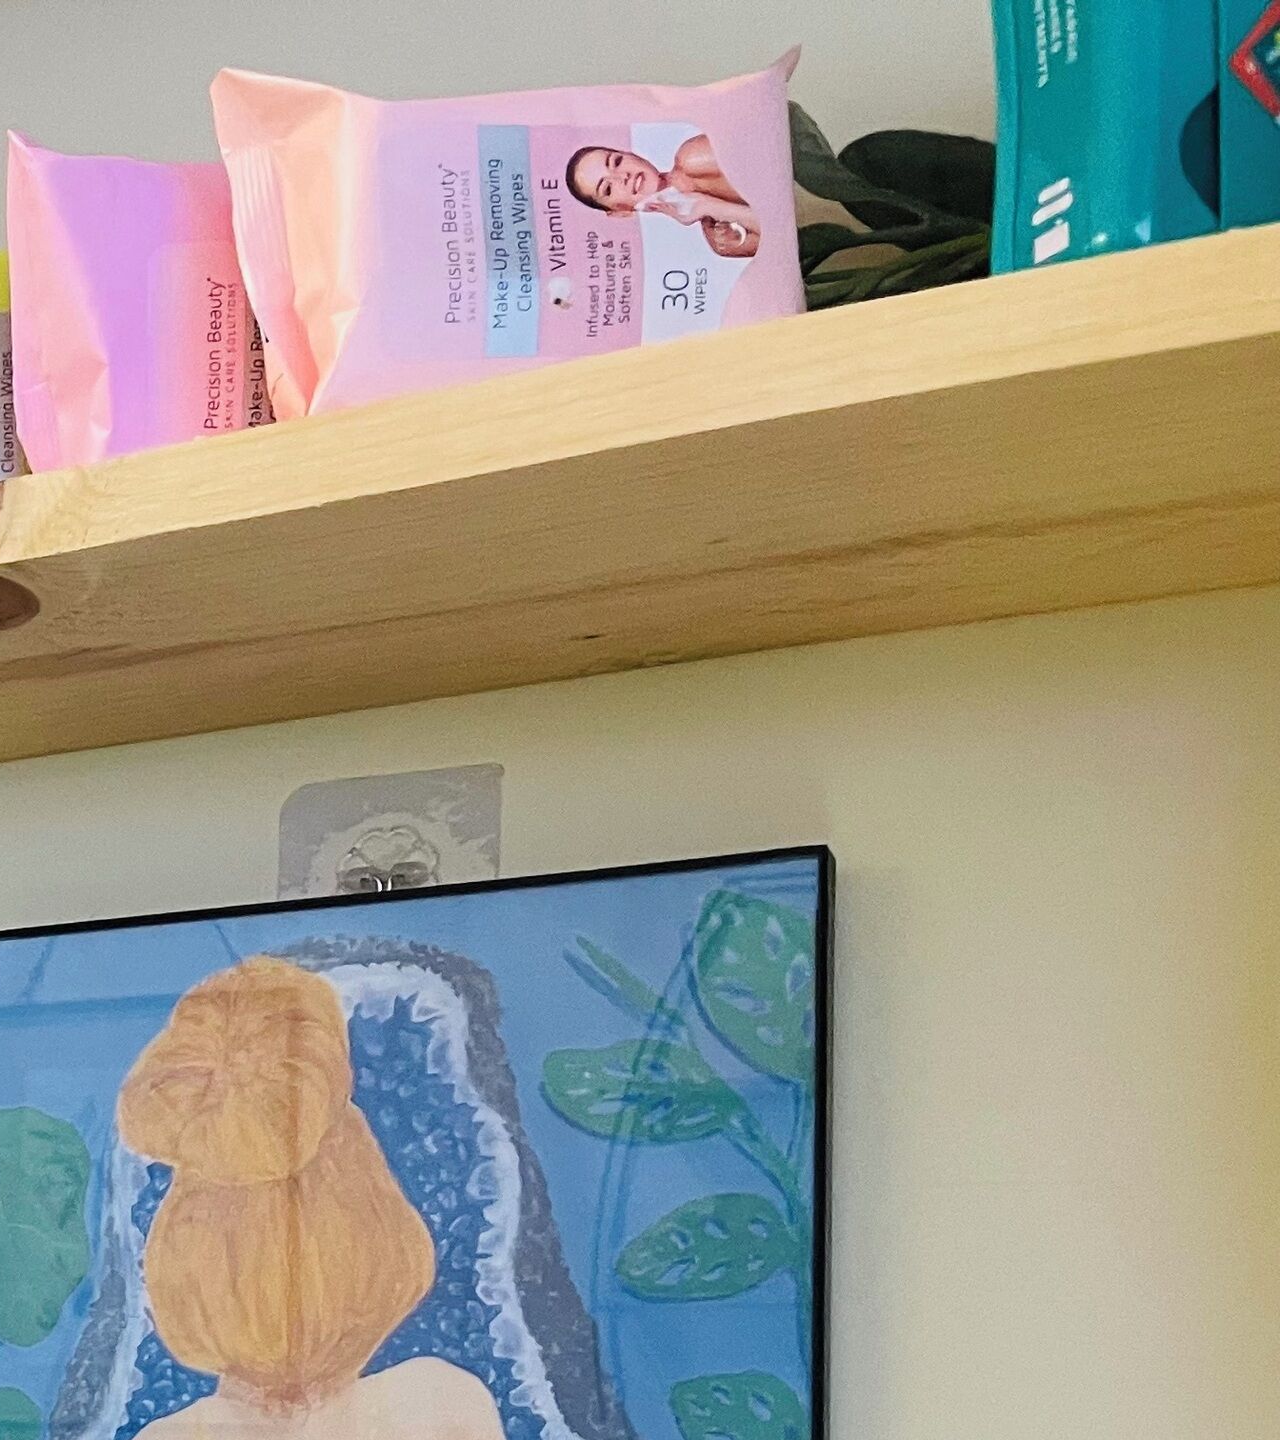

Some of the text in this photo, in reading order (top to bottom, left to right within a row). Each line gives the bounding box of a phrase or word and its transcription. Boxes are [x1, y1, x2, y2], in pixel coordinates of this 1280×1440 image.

[441, 168, 461, 323] Precision Beauty
[461, 170, 474, 243] SOLUTIONS
[489, 159, 510, 329] Make-Up Removing
[512, 173, 532, 311] Cleansing Wipes
[542, 179, 566, 271] Vitamin E
[466, 251, 476, 283] CARE
[586, 231, 599, 337] Infused to Help
[619, 241, 631, 323] Soften Skin
[662, 270, 689, 311] 30
[694, 268, 708, 315] WIPES
[204, 280, 226, 429] Precision Beauty
[0, 402, 14, 473] Cleansing
